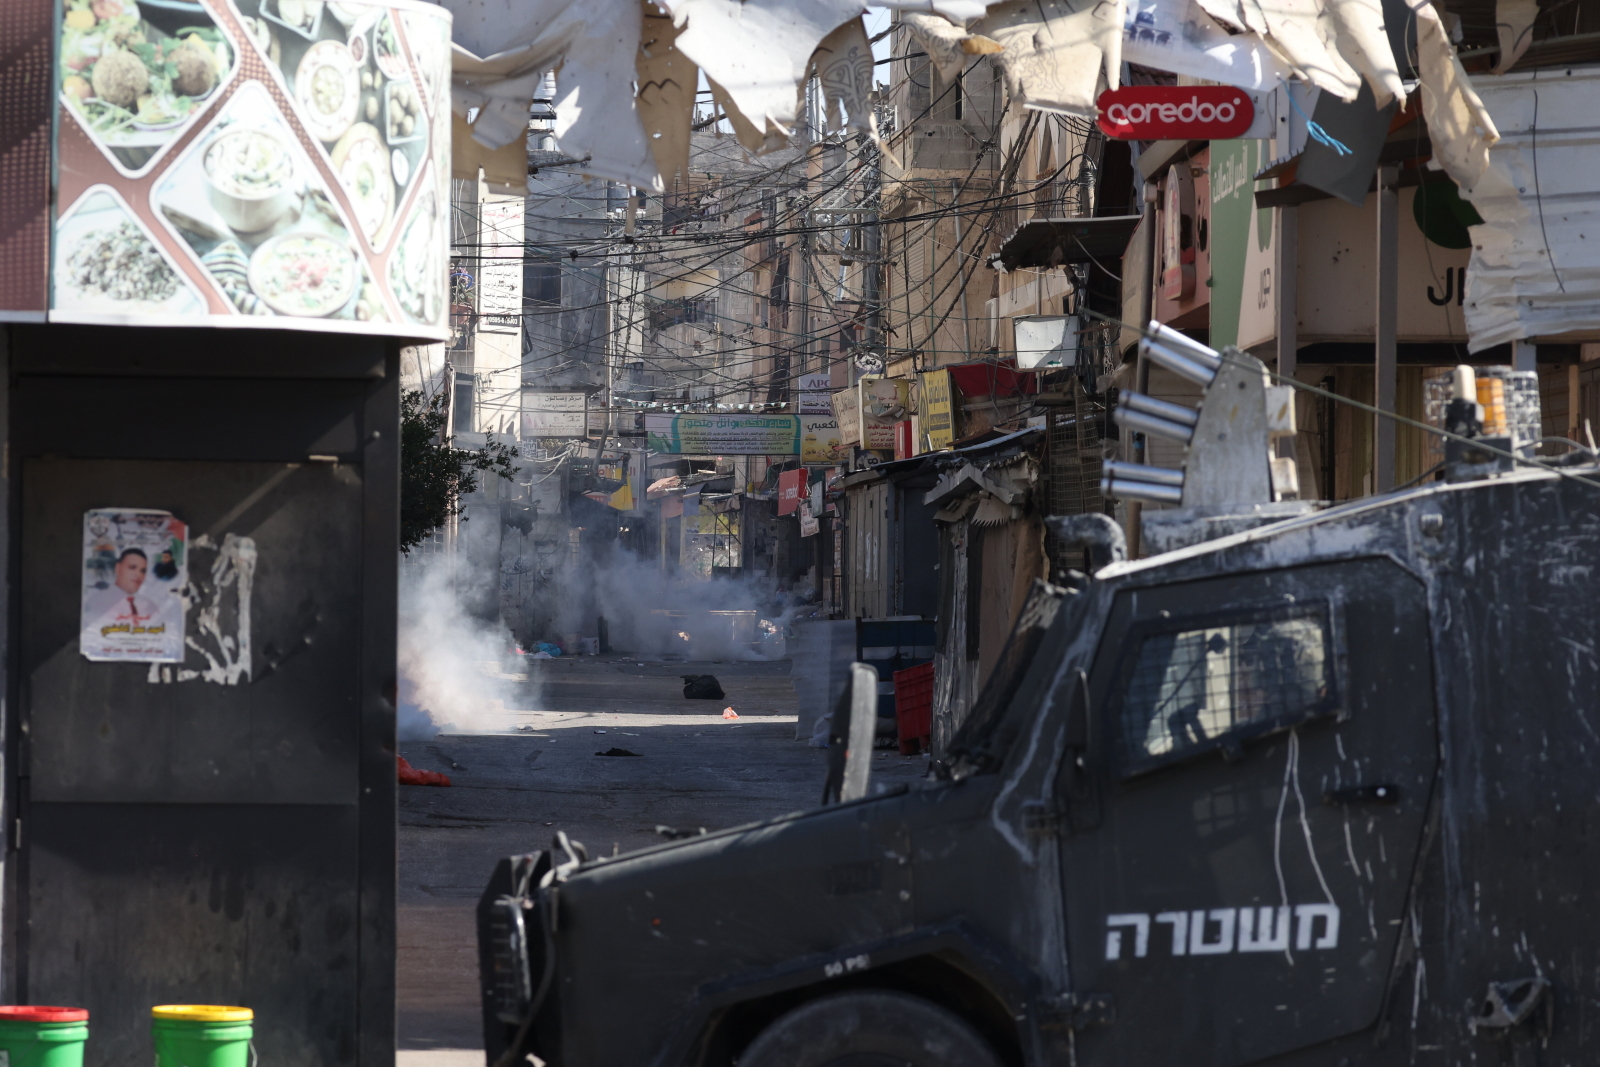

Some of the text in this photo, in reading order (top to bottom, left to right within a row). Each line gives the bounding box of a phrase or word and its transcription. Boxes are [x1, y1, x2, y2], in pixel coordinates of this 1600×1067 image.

[1107, 96, 1240, 124] ooredoo
[682, 417, 790, 429] شارع الدكتور وائل منصور
[1105, 903, 1340, 961] משטרה
